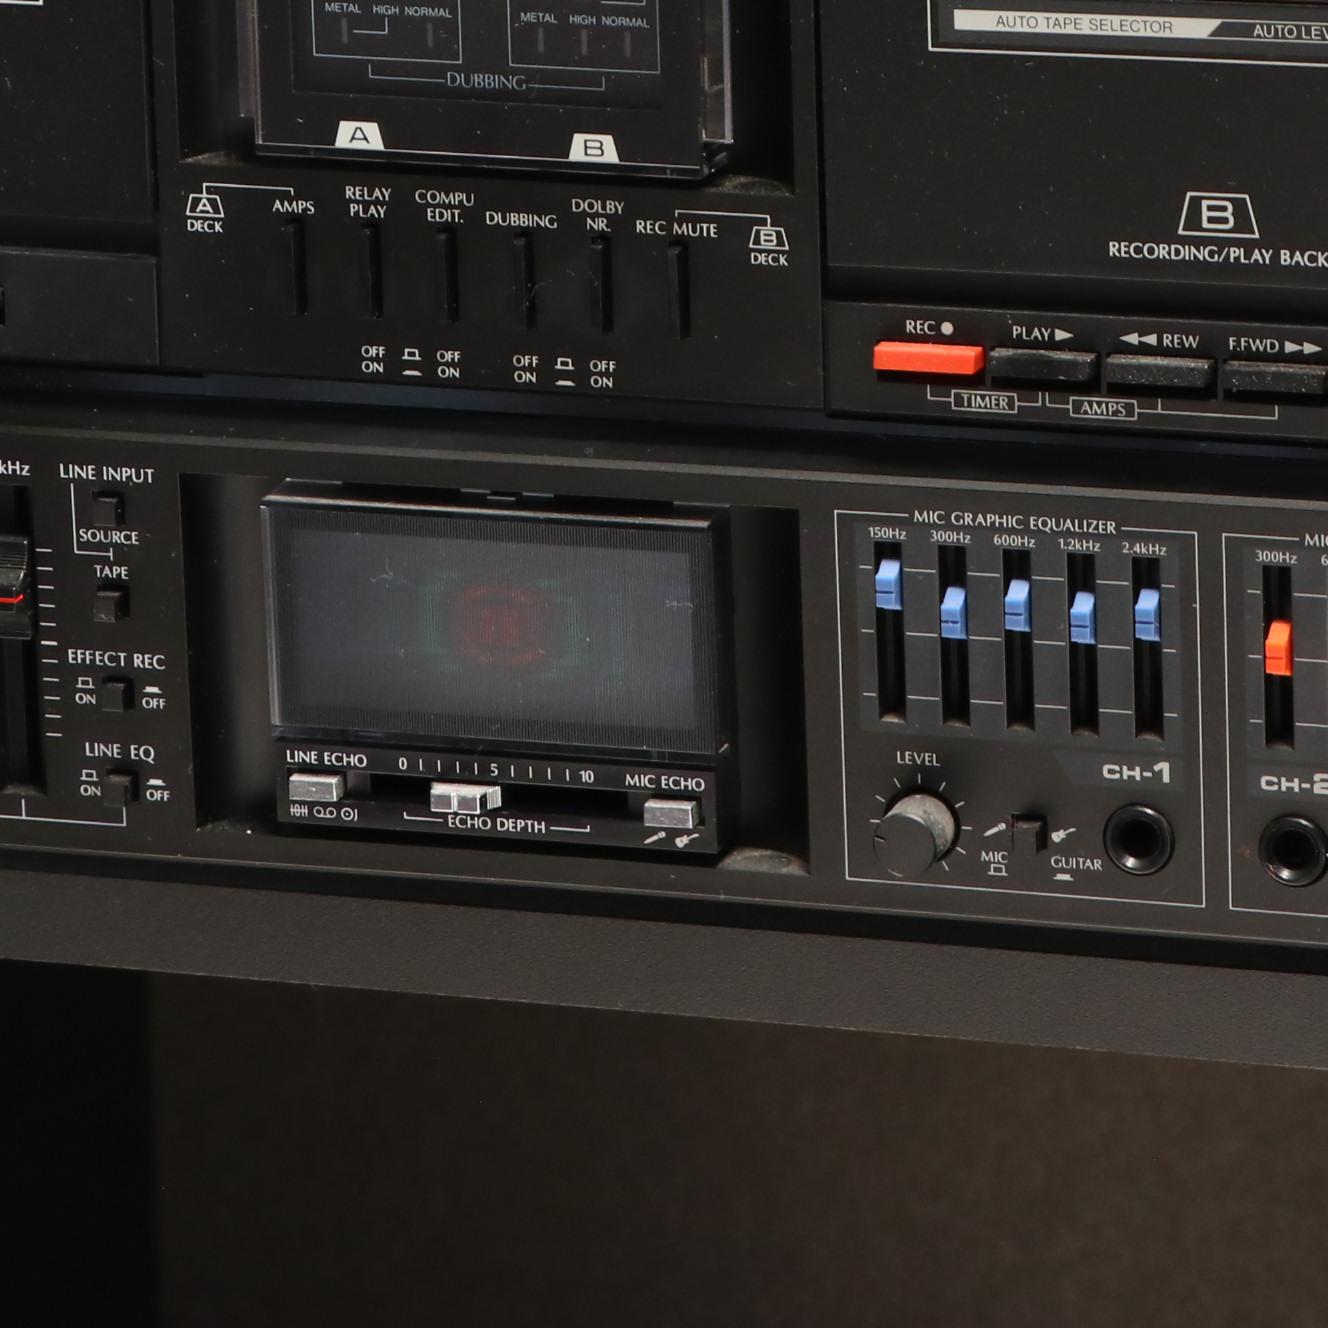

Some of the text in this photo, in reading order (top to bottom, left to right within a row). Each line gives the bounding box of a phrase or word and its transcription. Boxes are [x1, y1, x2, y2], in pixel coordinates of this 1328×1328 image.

[325, 2, 452, 18] METAL HIGH NORMAL
[995, 14, 1173, 35] AUTO TAPE SELECTOR
[1252, 23, 1298, 40] AUTO
[447, 72, 526, 90] DUBBING
[345, 185, 392, 202] RELAY
[415, 189, 475, 207] COMPU
[272, 199, 315, 215] AMPS
[349, 203, 387, 219] PLAY
[571, 198, 624, 215] DOLBY
[1201, 199, 1235, 230] B
[426, 208, 464, 223] EDIT.
[486, 211, 558, 229] DUBBING
[586, 217, 611, 233] NR.
[636, 220, 718, 238] REC MUTE
[1108, 240, 1328, 268] RECORDING/PLAY BACK
[905, 320, 936, 335] REC
[1012, 325, 1051, 342] PLAY
[1162, 333, 1199, 349] REW
[1229, 337, 1279, 353] F.FWD
[59, 463, 154, 484] LINE INPUT
[914, 510, 1117, 535] MIC GRAPHIC EQUALIZER
[79, 528, 139, 546] SOURCE
[868, 527, 907, 540] 150Hz
[930, 529, 972, 545] 300Hz
[993, 534, 1036, 548] 600Hz
[1057, 537, 1101, 553] 1.2kHz
[1122, 541, 1167, 556] 2.4kHz
[93, 564, 129, 580] TAPE
[67, 648, 166, 670] EFFECT REC
[85, 742, 155, 764] LINE EQ
[286, 749, 367, 768] LINE ECHO
[897, 750, 941, 767] LEVEL
[1102, 761, 1170, 784] CH-1
[625, 773, 705, 792] MIC ECHO
[448, 814, 546, 834] ECHO DEPTH
[981, 850, 1008, 865] MIC
[1051, 855, 1102, 871] GUITAR
